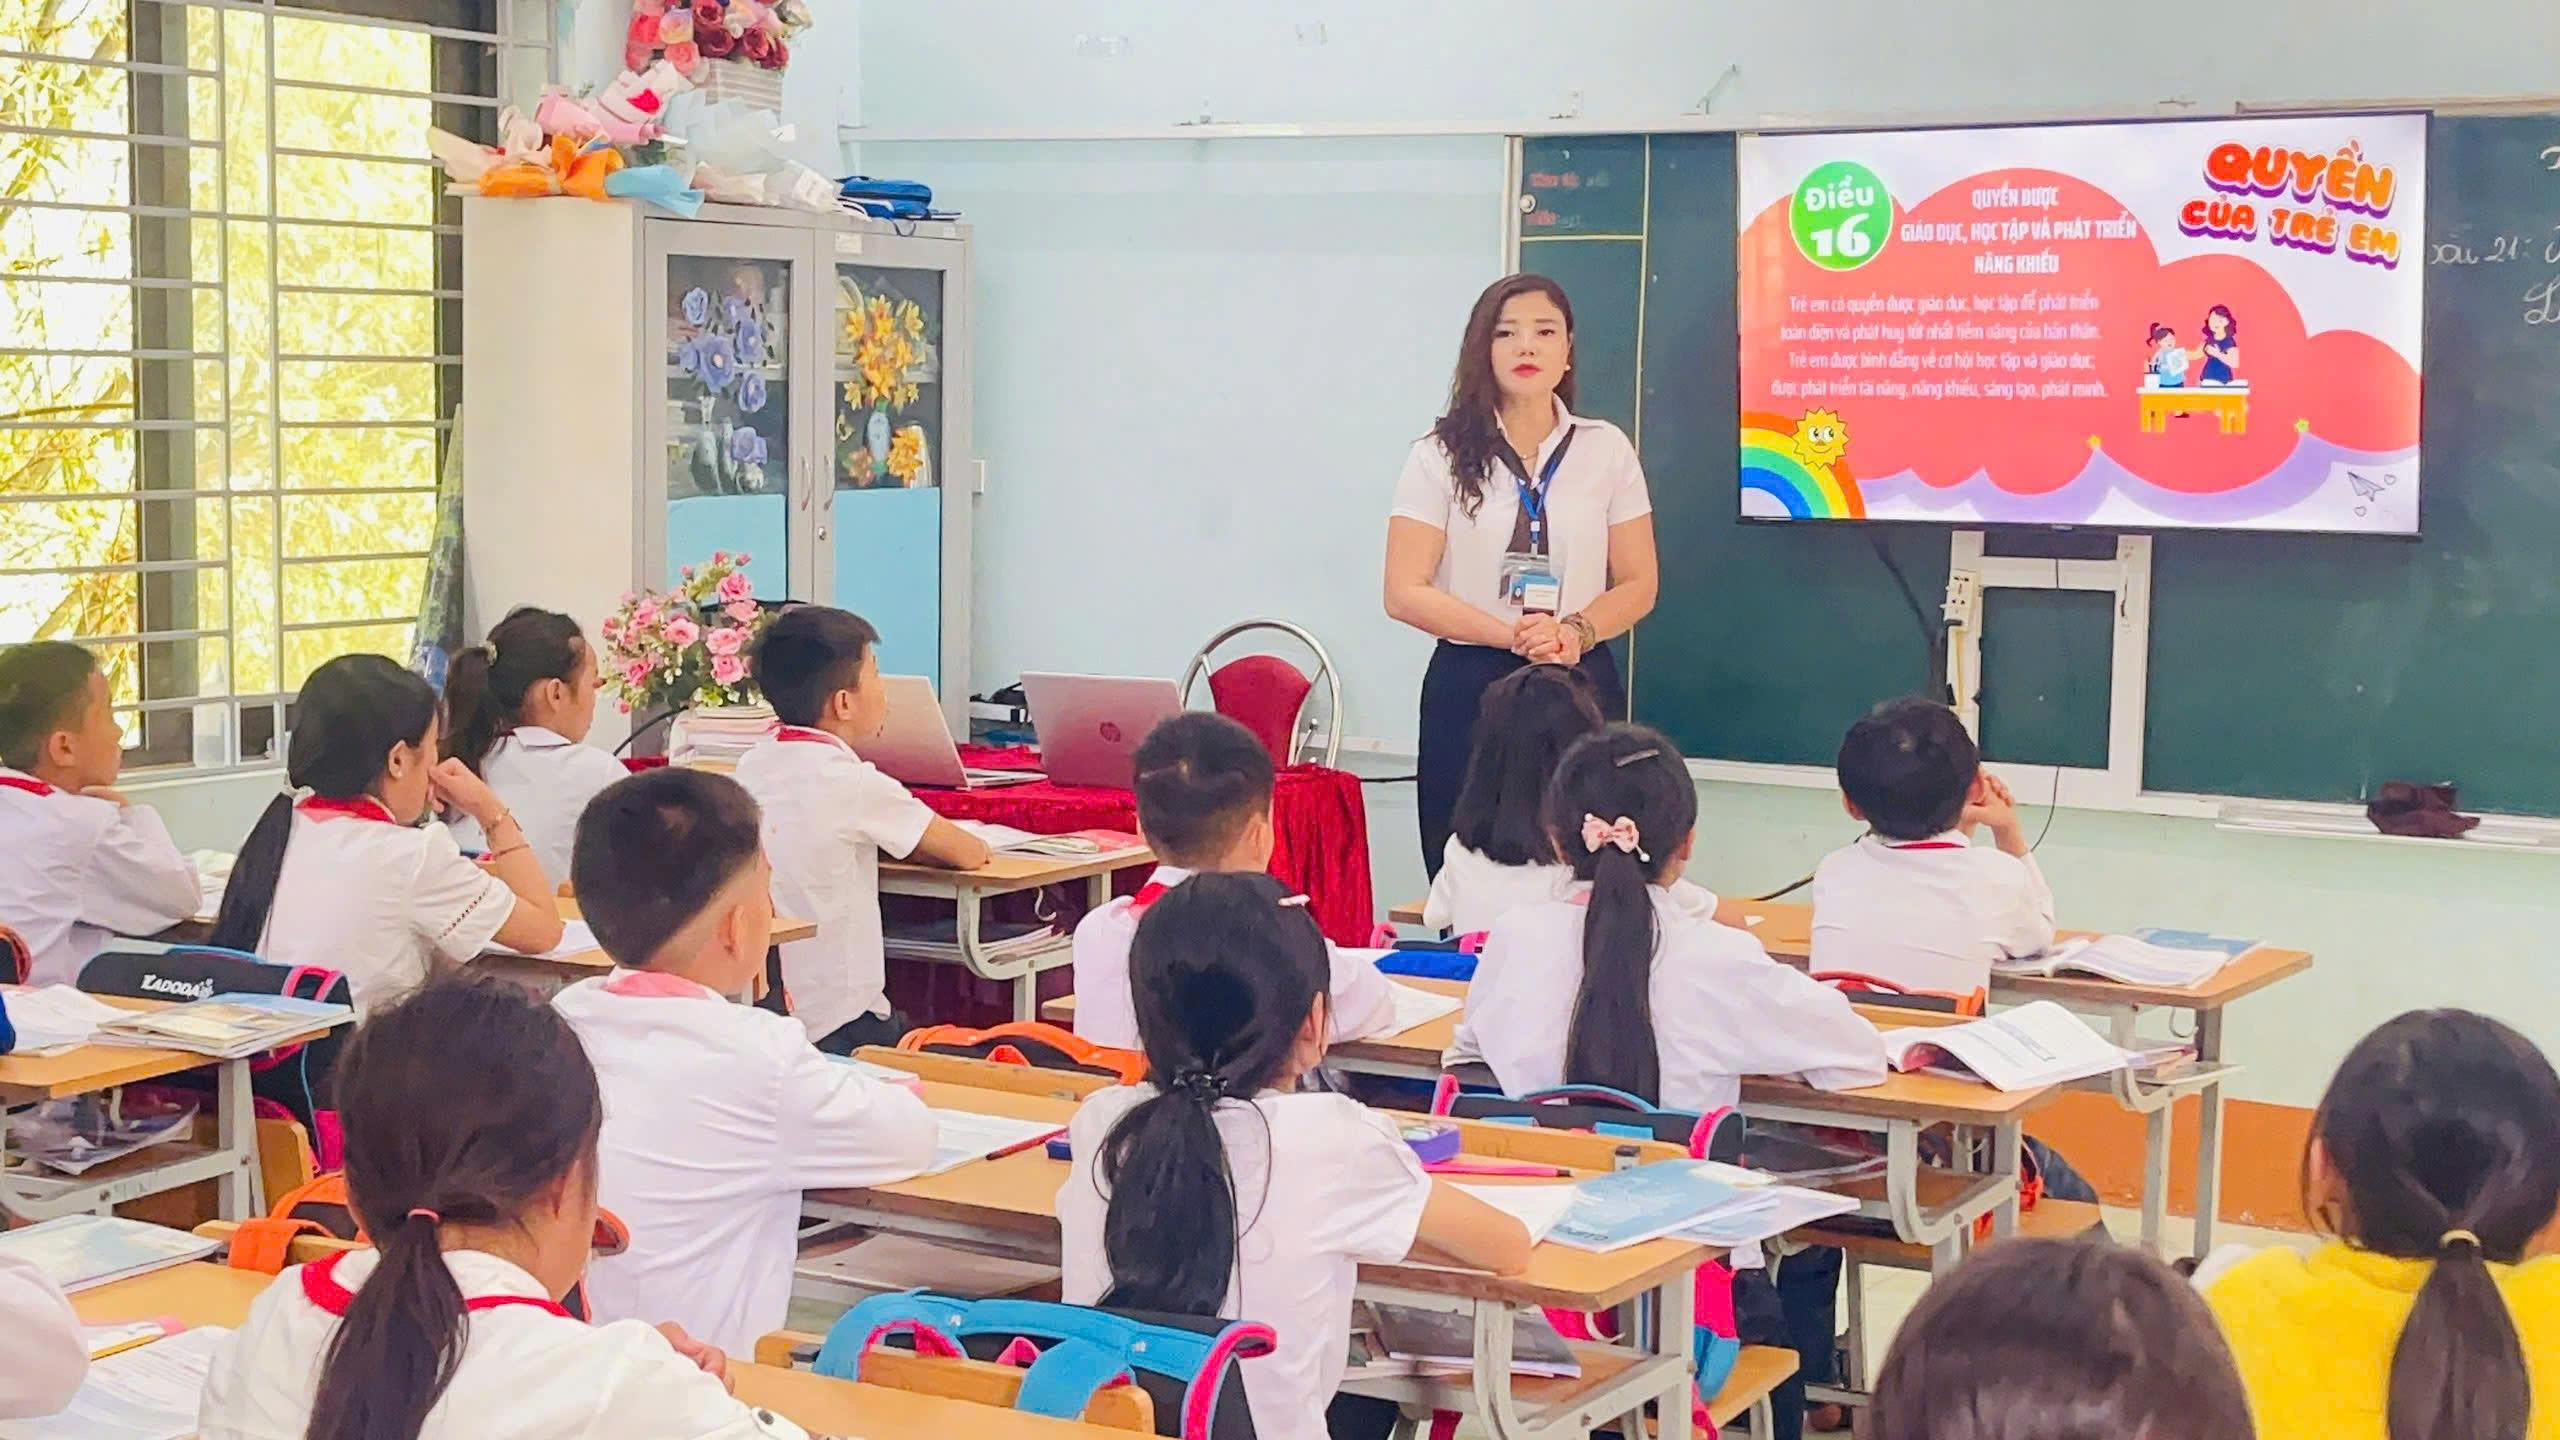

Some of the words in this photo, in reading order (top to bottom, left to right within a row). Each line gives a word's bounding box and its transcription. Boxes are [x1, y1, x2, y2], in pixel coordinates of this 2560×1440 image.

[1805, 175, 1874, 212] Điều
[2204, 138, 2396, 214] QUYỀN
[1811, 213, 1871, 257] 16
[1901, 219, 1934, 242] GIÁO
[1970, 222, 1999, 245] HỌC
[2000, 217, 2029, 245] TẬP
[2031, 216, 2050, 241] VÀ
[2053, 216, 2091, 241] PHÁT
[2179, 193, 2257, 238] CỦA
[2269, 206, 2338, 250] TRẺ
[2347, 222, 2399, 266] EM
[1810, 299, 1829, 312] em
[1809, 356, 1828, 368] em
